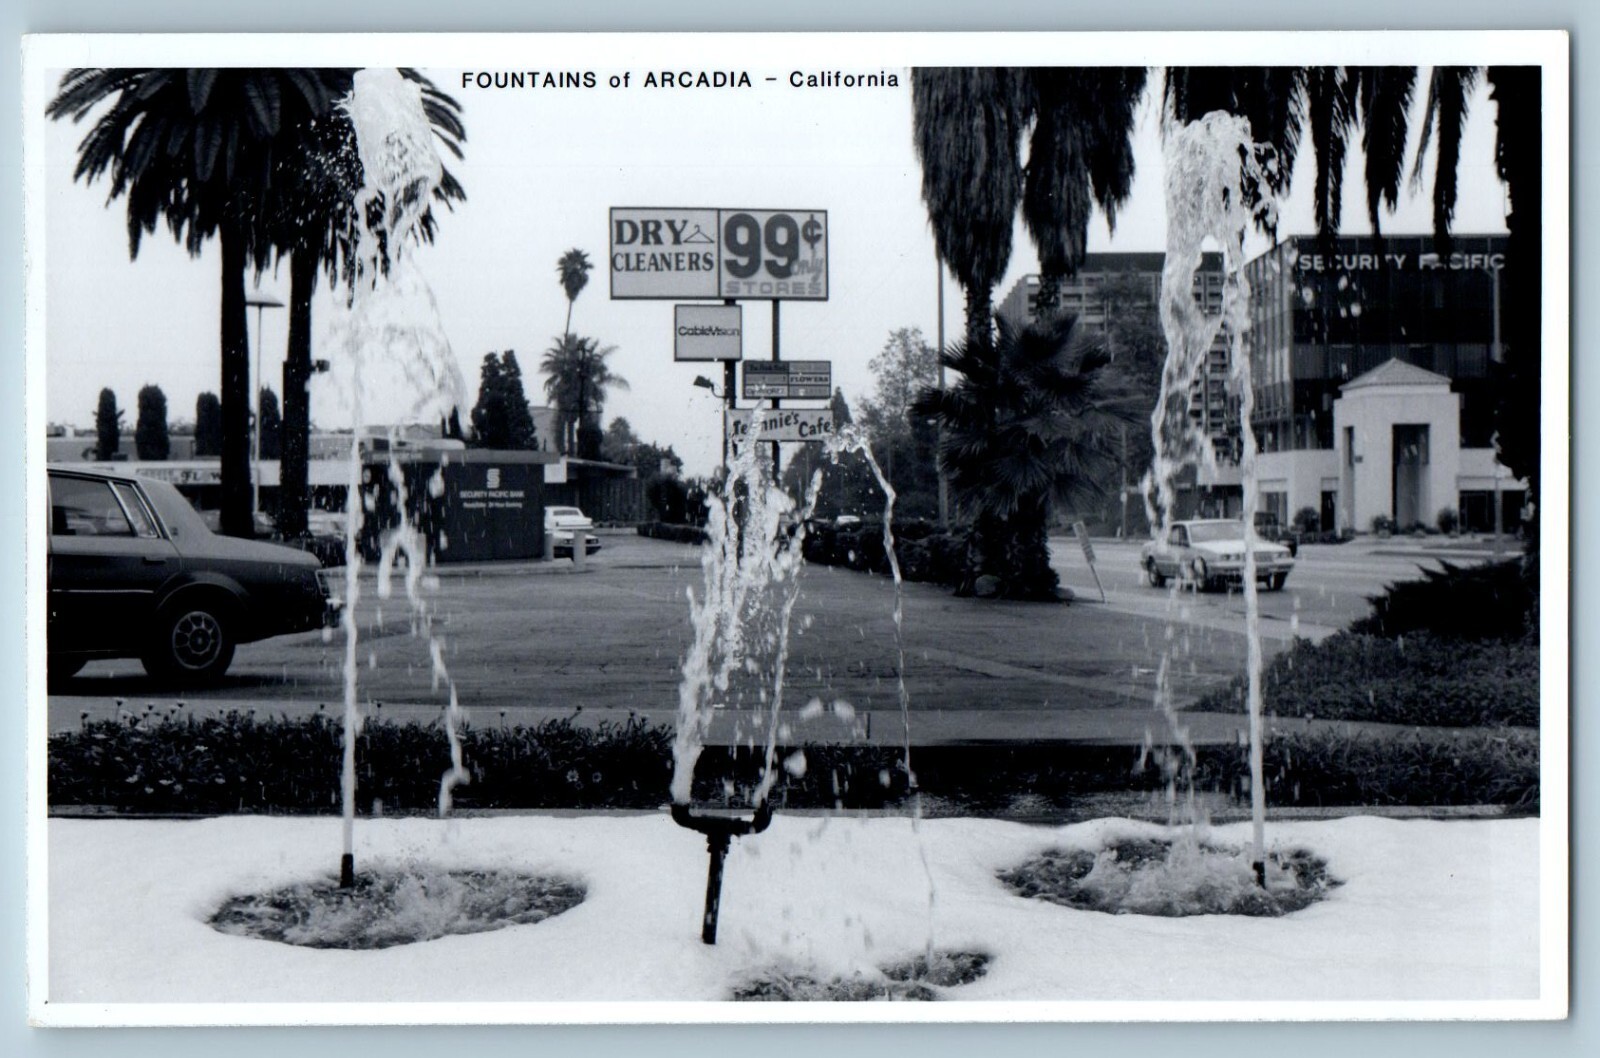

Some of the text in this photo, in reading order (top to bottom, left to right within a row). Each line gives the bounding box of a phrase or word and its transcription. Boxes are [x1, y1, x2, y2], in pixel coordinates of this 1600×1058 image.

[614, 219, 688, 246] DRY
[612, 252, 714, 272] CLEANERS
[725, 281, 822, 295] STORES
[798, 416, 831, 438] Cafe
